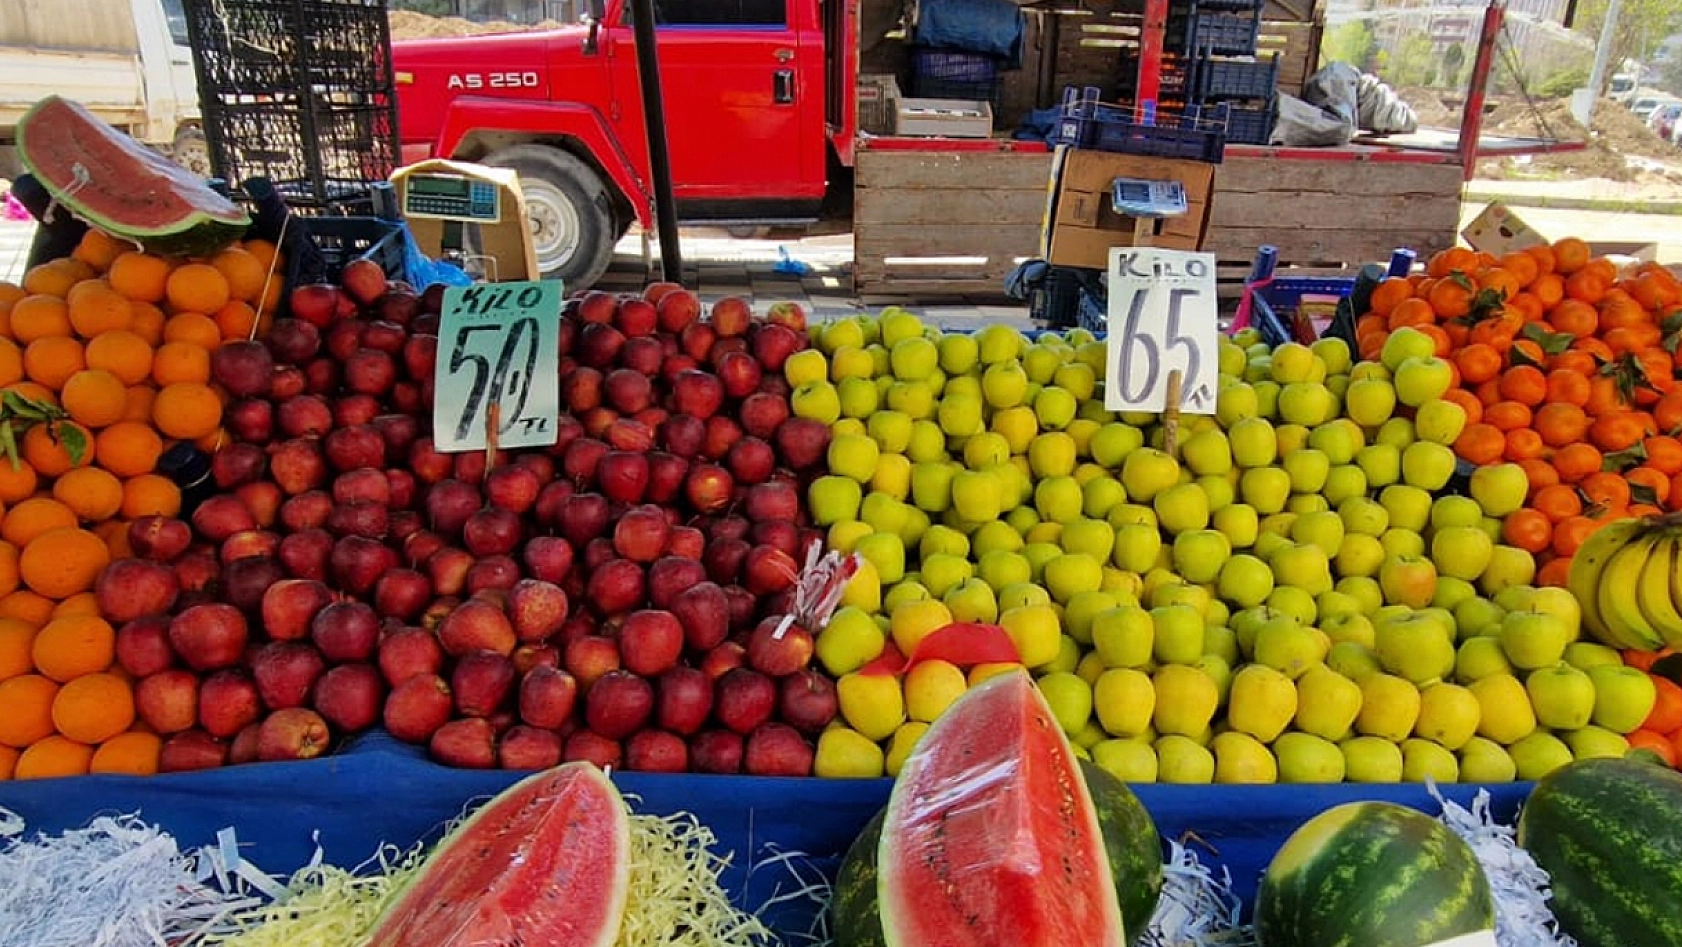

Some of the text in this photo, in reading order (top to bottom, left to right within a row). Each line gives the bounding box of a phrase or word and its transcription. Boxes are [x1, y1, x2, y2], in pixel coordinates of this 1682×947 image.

[447, 72, 538, 89] AS 250
[450, 317, 548, 441] 50 TL
[1118, 288, 1201, 405] 65
